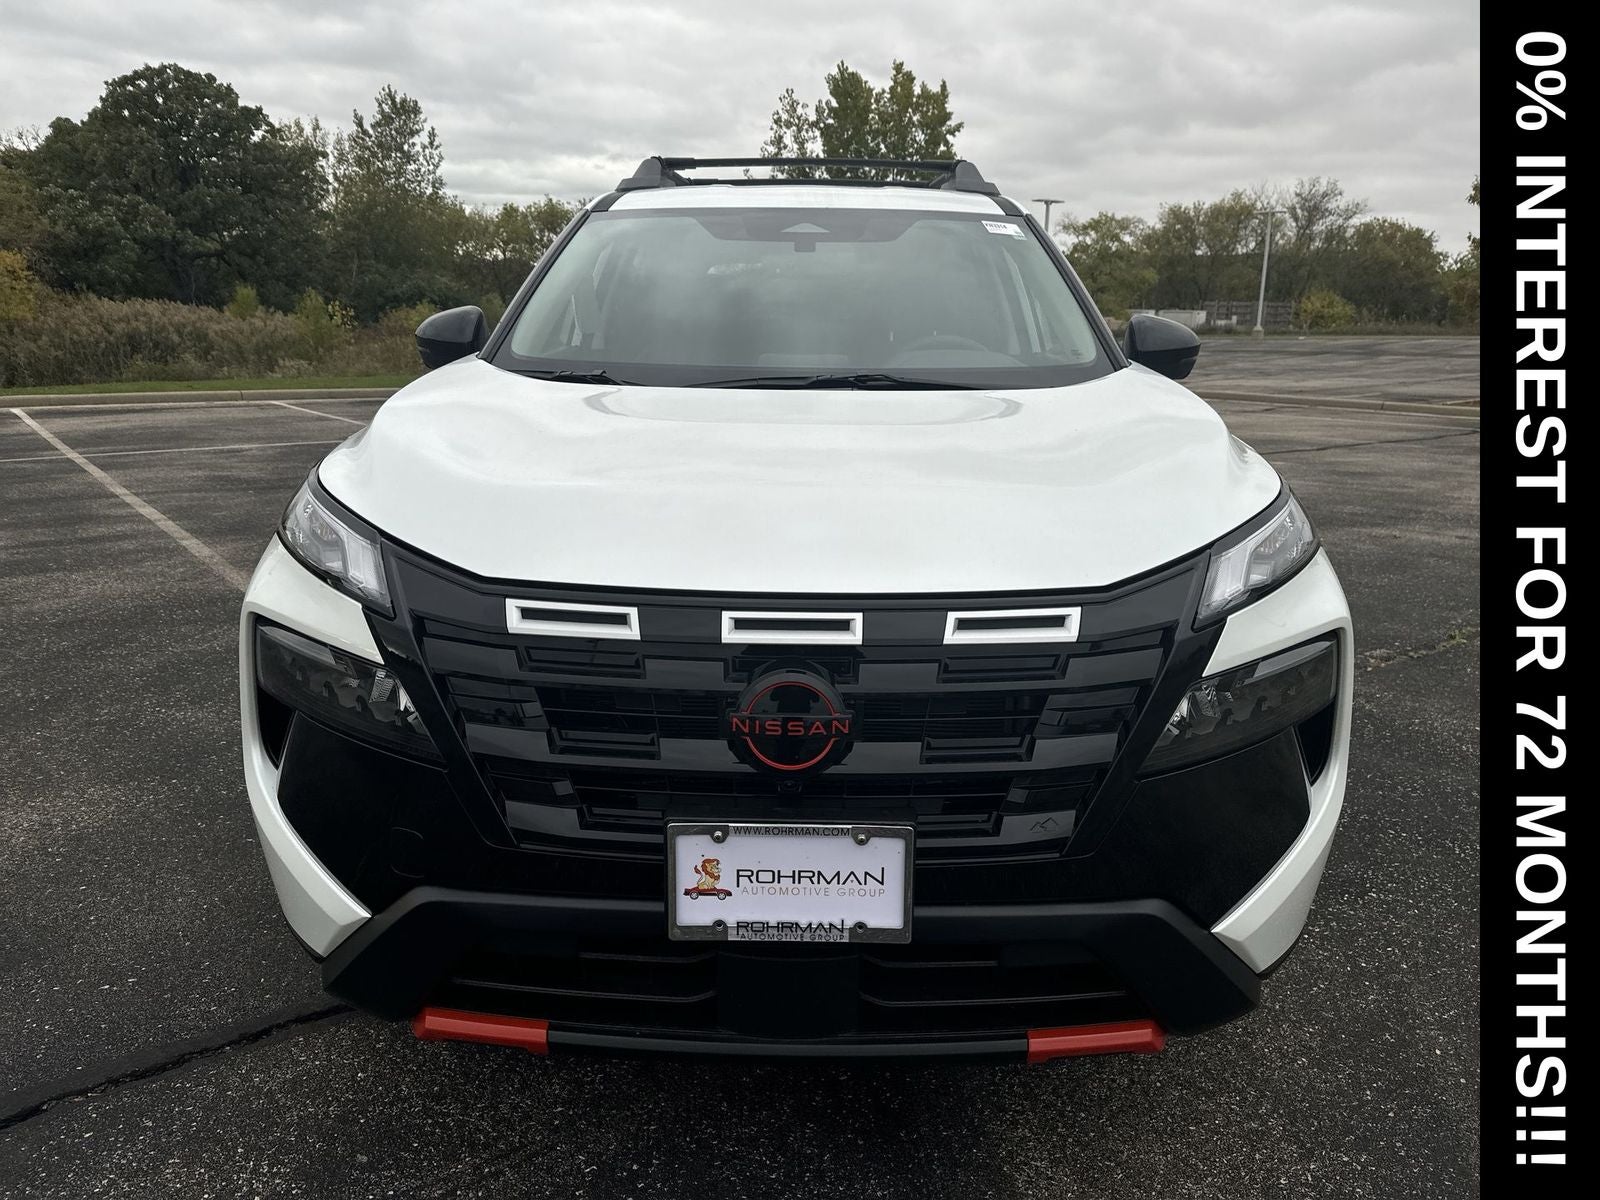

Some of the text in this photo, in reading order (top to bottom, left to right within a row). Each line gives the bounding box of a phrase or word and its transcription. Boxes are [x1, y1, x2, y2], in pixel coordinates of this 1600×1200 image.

[731, 716, 850, 736] NISSAN
[732, 826, 851, 837] WWW.ROHRMAN.COM
[736, 867, 885, 888] ROHRMAN
[741, 886, 886, 898] AUTOMOTIVE GROUP
[736, 919, 845, 935] ROHRMAN
[740, 932, 846, 942] AUTOMOTIVE GROUP
